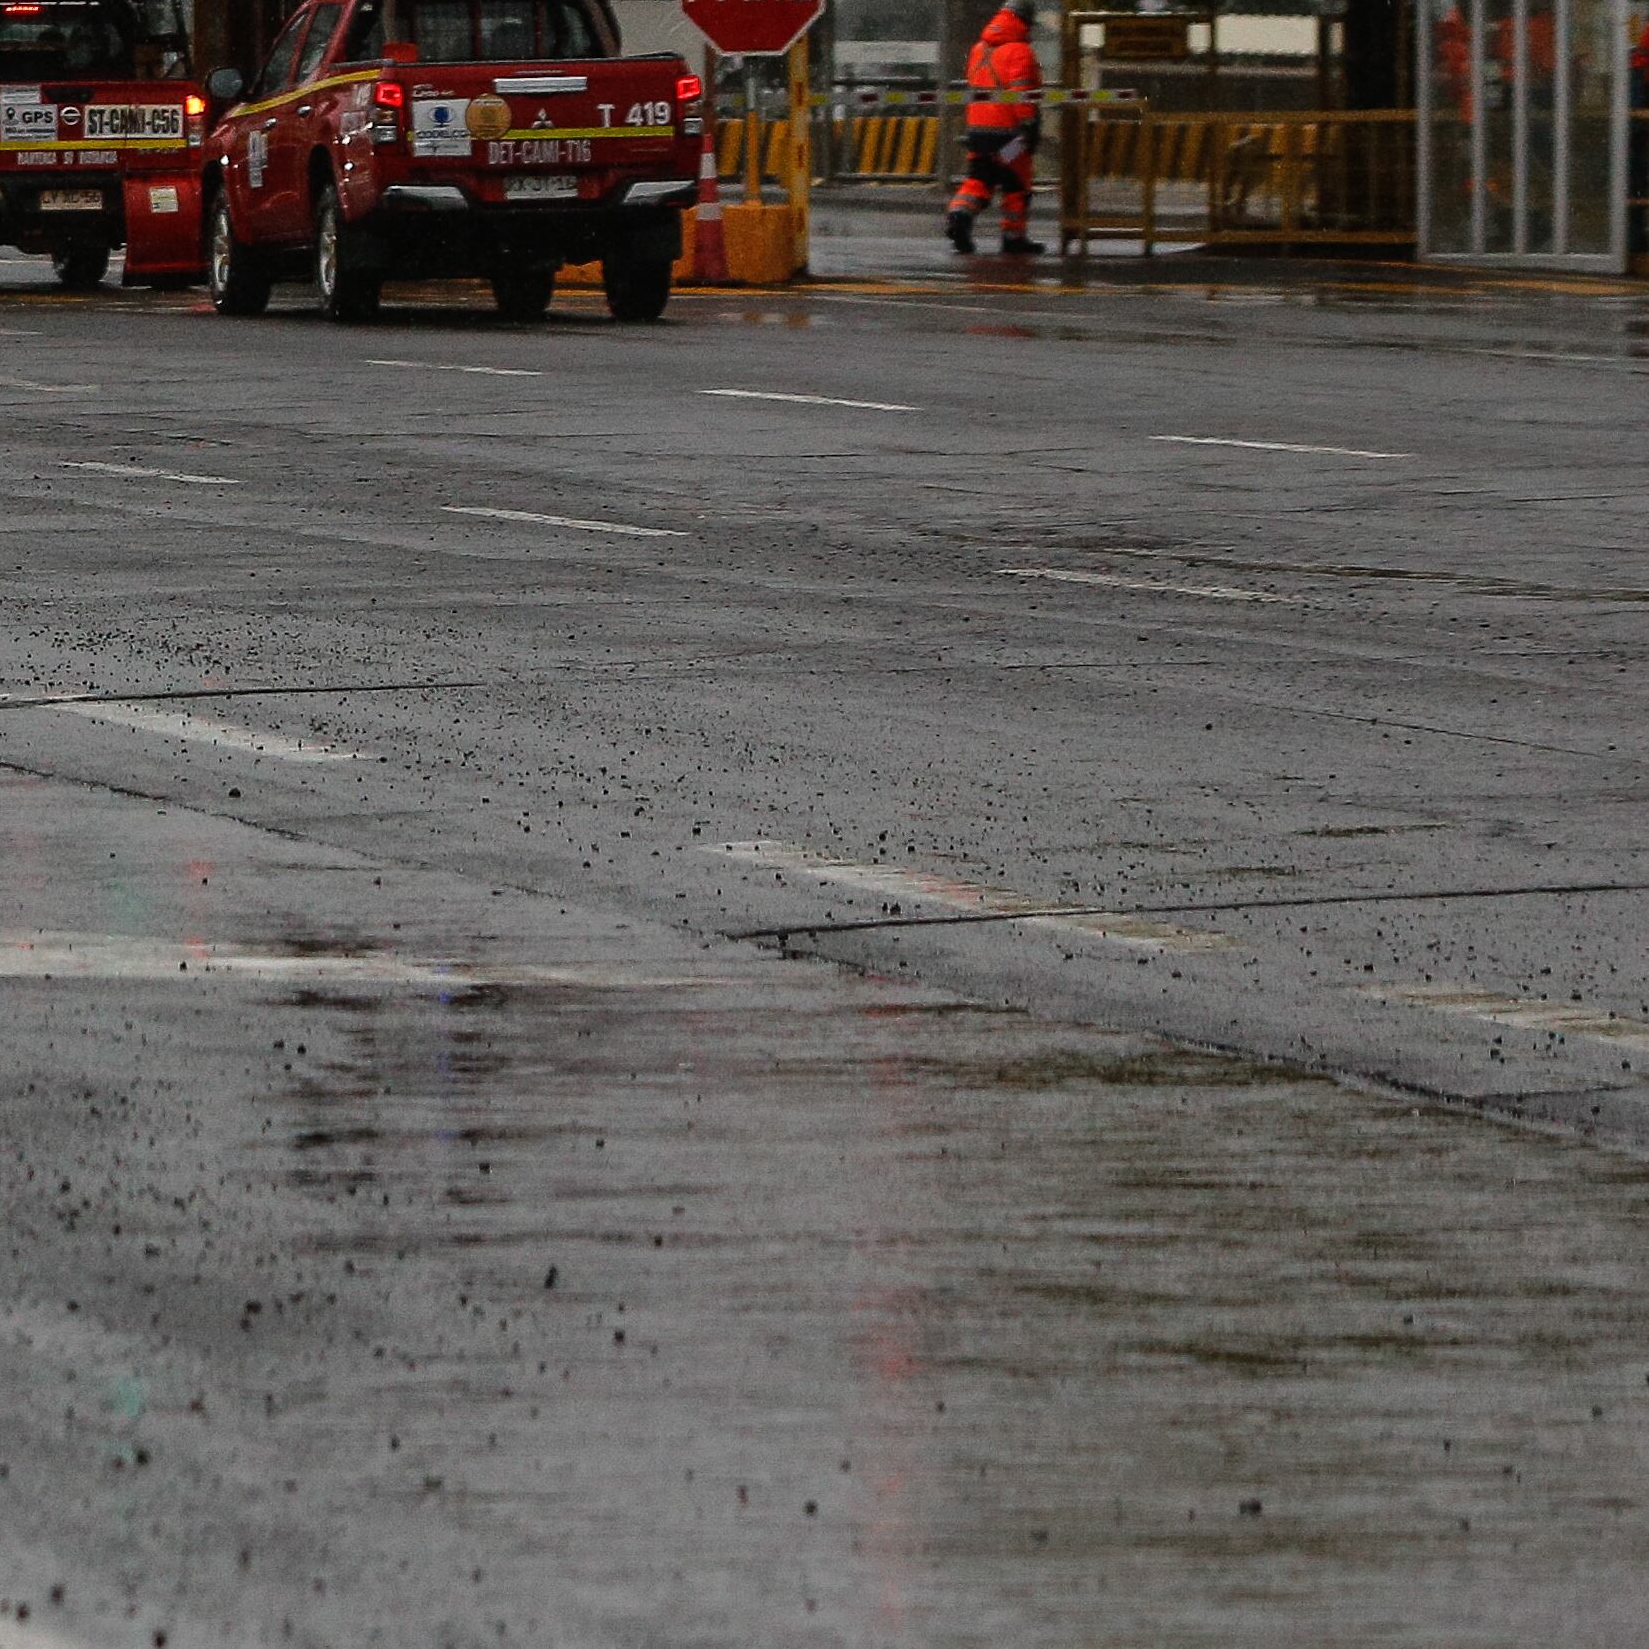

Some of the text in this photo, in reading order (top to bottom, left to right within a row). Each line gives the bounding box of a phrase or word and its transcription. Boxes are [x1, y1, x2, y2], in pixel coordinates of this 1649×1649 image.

[22, 111, 53, 124] GPS
[596, 102, 672, 128] T 419
